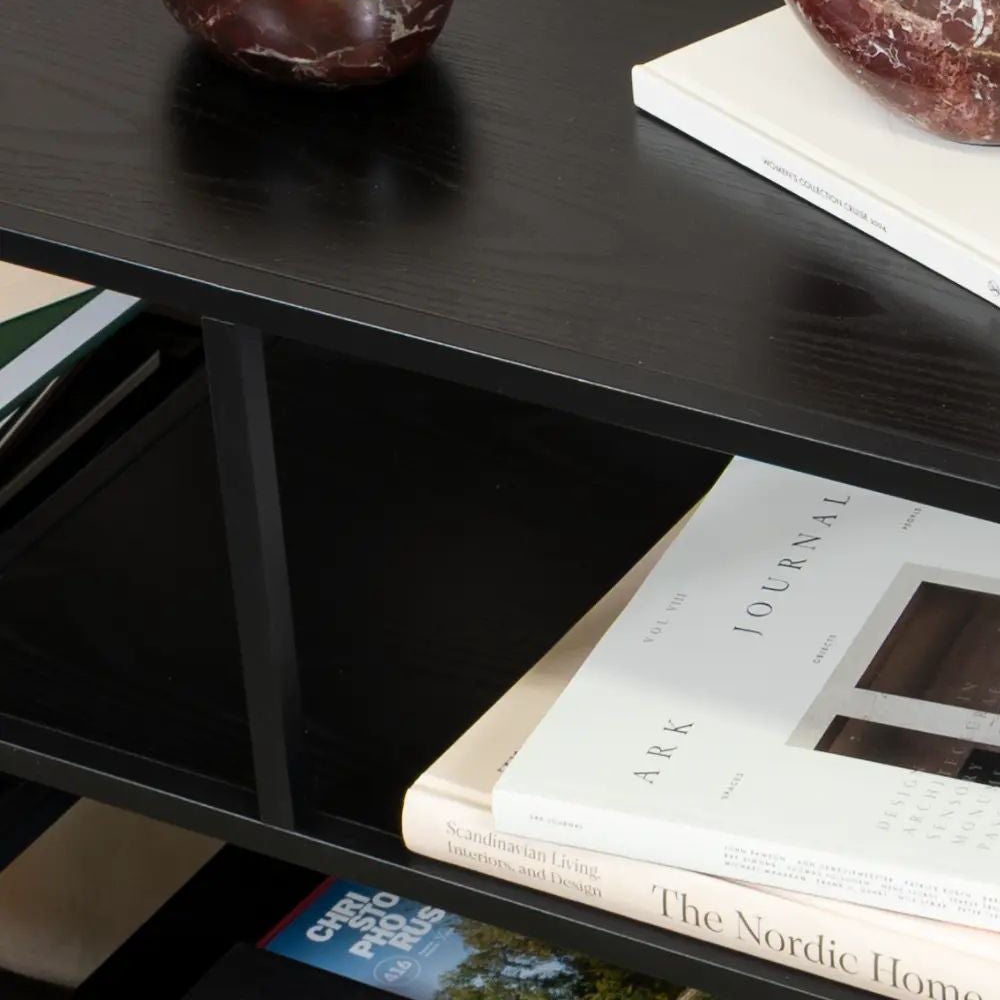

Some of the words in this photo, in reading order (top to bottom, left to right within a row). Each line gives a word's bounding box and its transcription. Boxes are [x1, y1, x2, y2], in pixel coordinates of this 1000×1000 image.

[799, 177, 842, 206] COLLECTION
[633, 719, 695, 784] ARK
[733, 495, 850, 637] JOURNAL
[446, 821, 546, 863] Scandinavian
[448, 841, 516, 873] Interiors,
[518, 866, 546, 881] and
[551, 872, 603, 898] Design
[306, 891, 370, 942] CHRI
[348, 891, 399, 931] STO
[388, 905, 446, 952] RUS
[652, 884, 724, 933] The
[735, 910, 858, 975] Nordic
[348, 913, 407, 960] PHO
